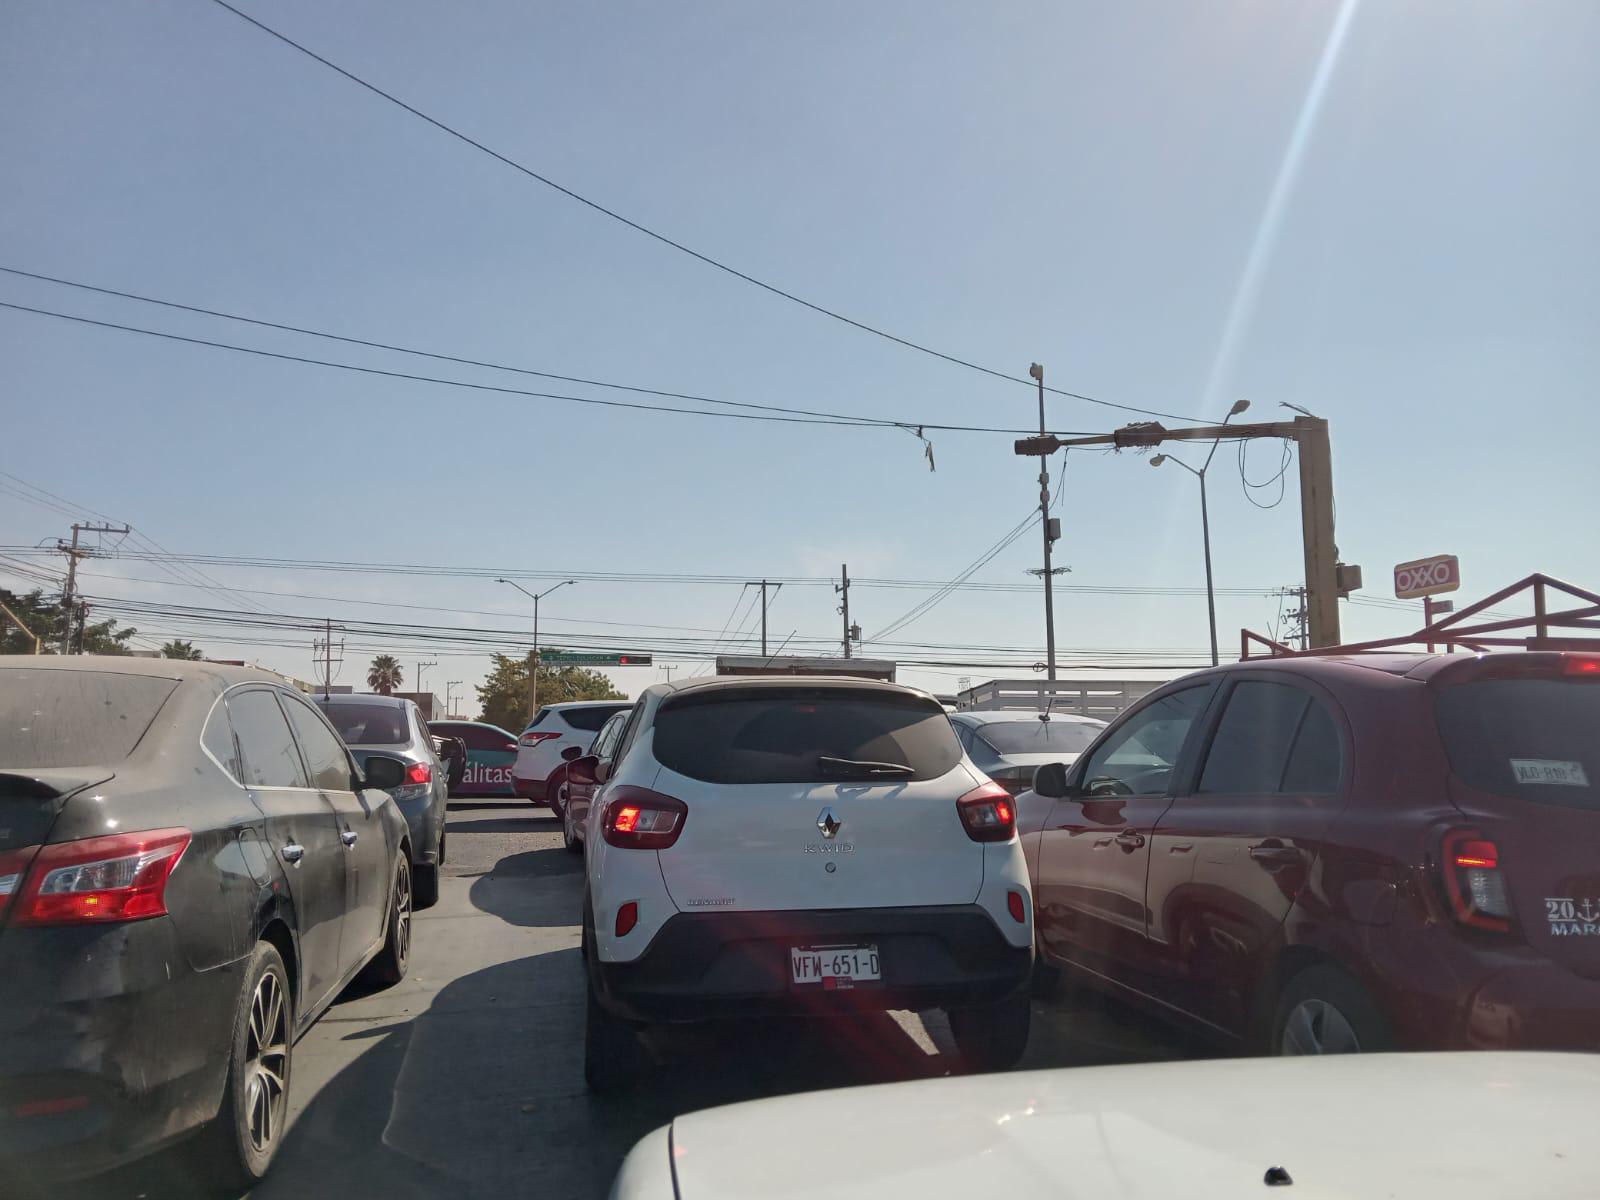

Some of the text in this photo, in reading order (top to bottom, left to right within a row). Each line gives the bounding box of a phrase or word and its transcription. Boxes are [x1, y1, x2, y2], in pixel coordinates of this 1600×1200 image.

[1396, 561, 1450, 592] OXXO
[804, 842, 855, 853] KWID
[1551, 923, 1600, 936] MAR
[793, 953, 880, 978] VFW-651-D
